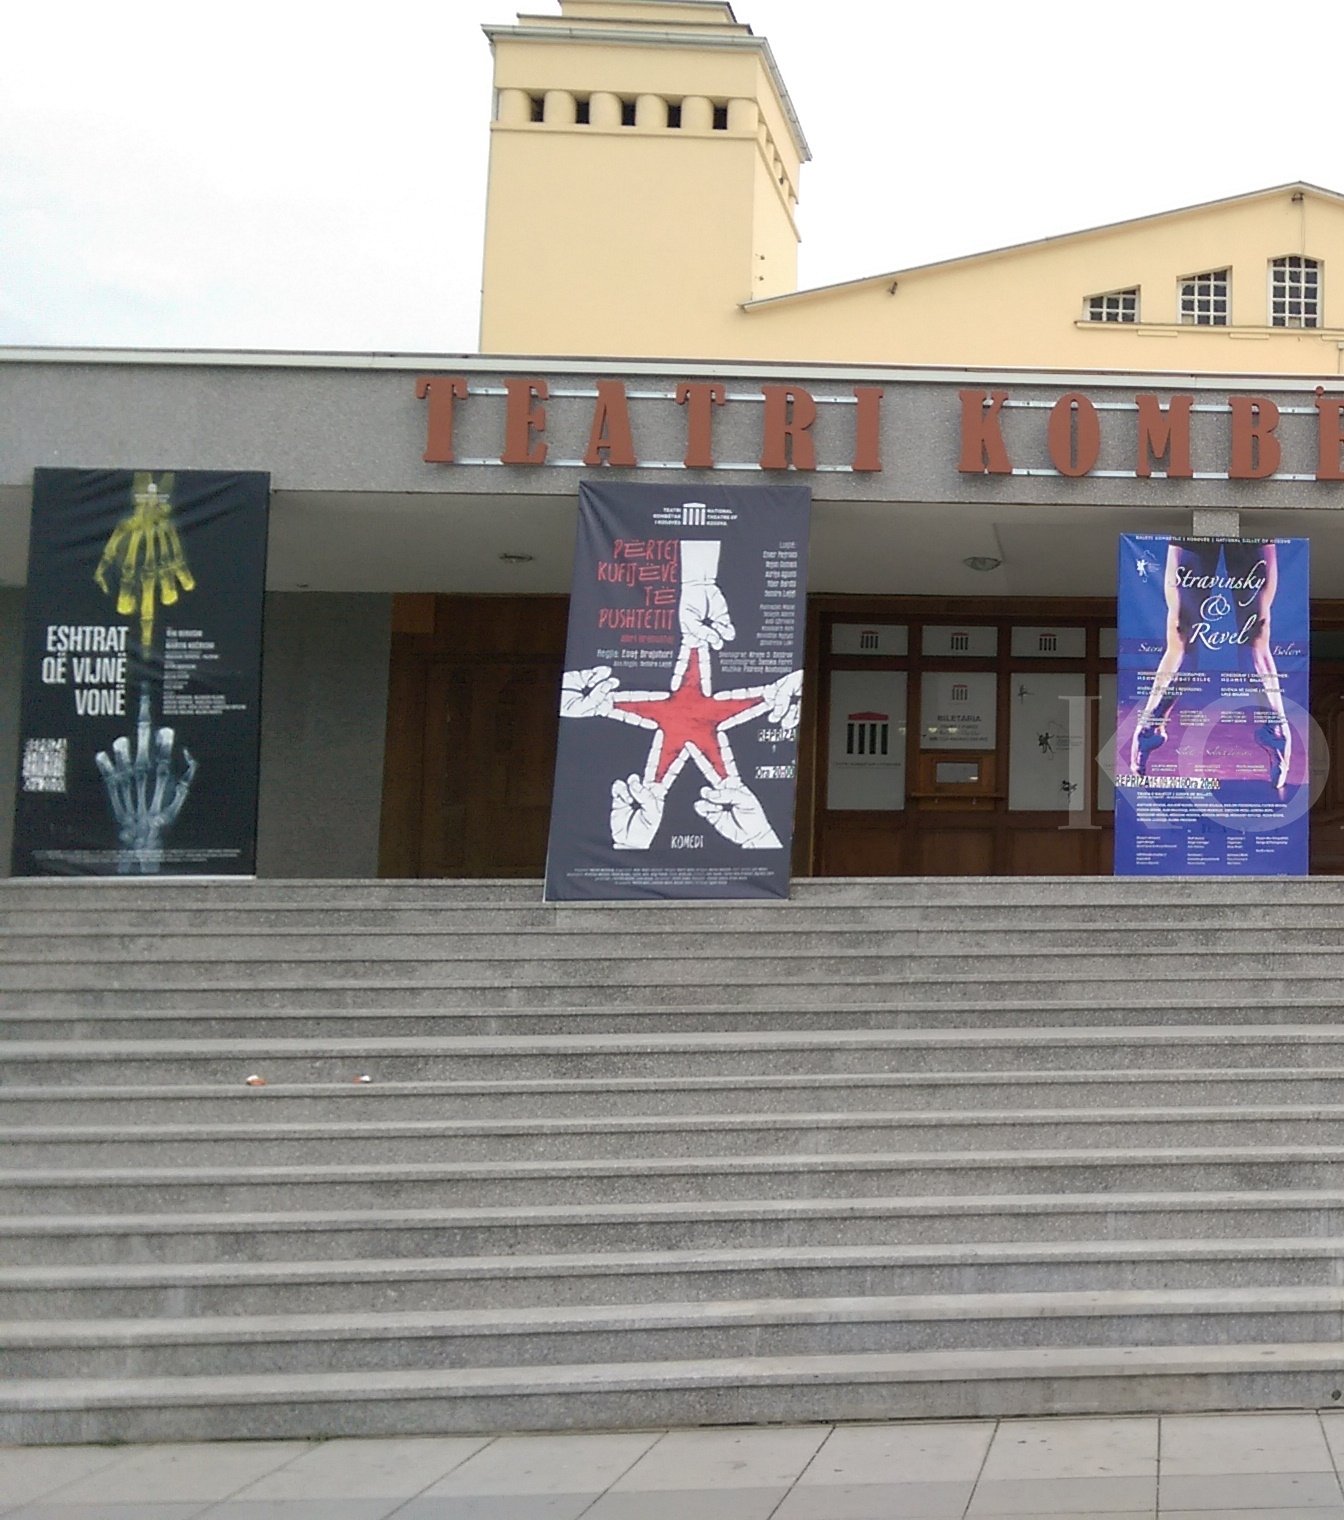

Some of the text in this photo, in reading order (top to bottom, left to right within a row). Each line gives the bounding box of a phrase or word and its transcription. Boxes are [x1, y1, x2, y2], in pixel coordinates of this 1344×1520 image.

[415, 376, 883, 473] TEATRI
[644, 585, 677, 606] TË
[1174, 560, 1267, 606] Stravinsky
[598, 608, 676, 630] PUSHTETIT
[1189, 614, 1258, 650] Ravel
[46, 625, 130, 652] ESHTRAT
[41, 652, 127, 684] QË VIJNË
[75, 684, 126, 716] VONË
